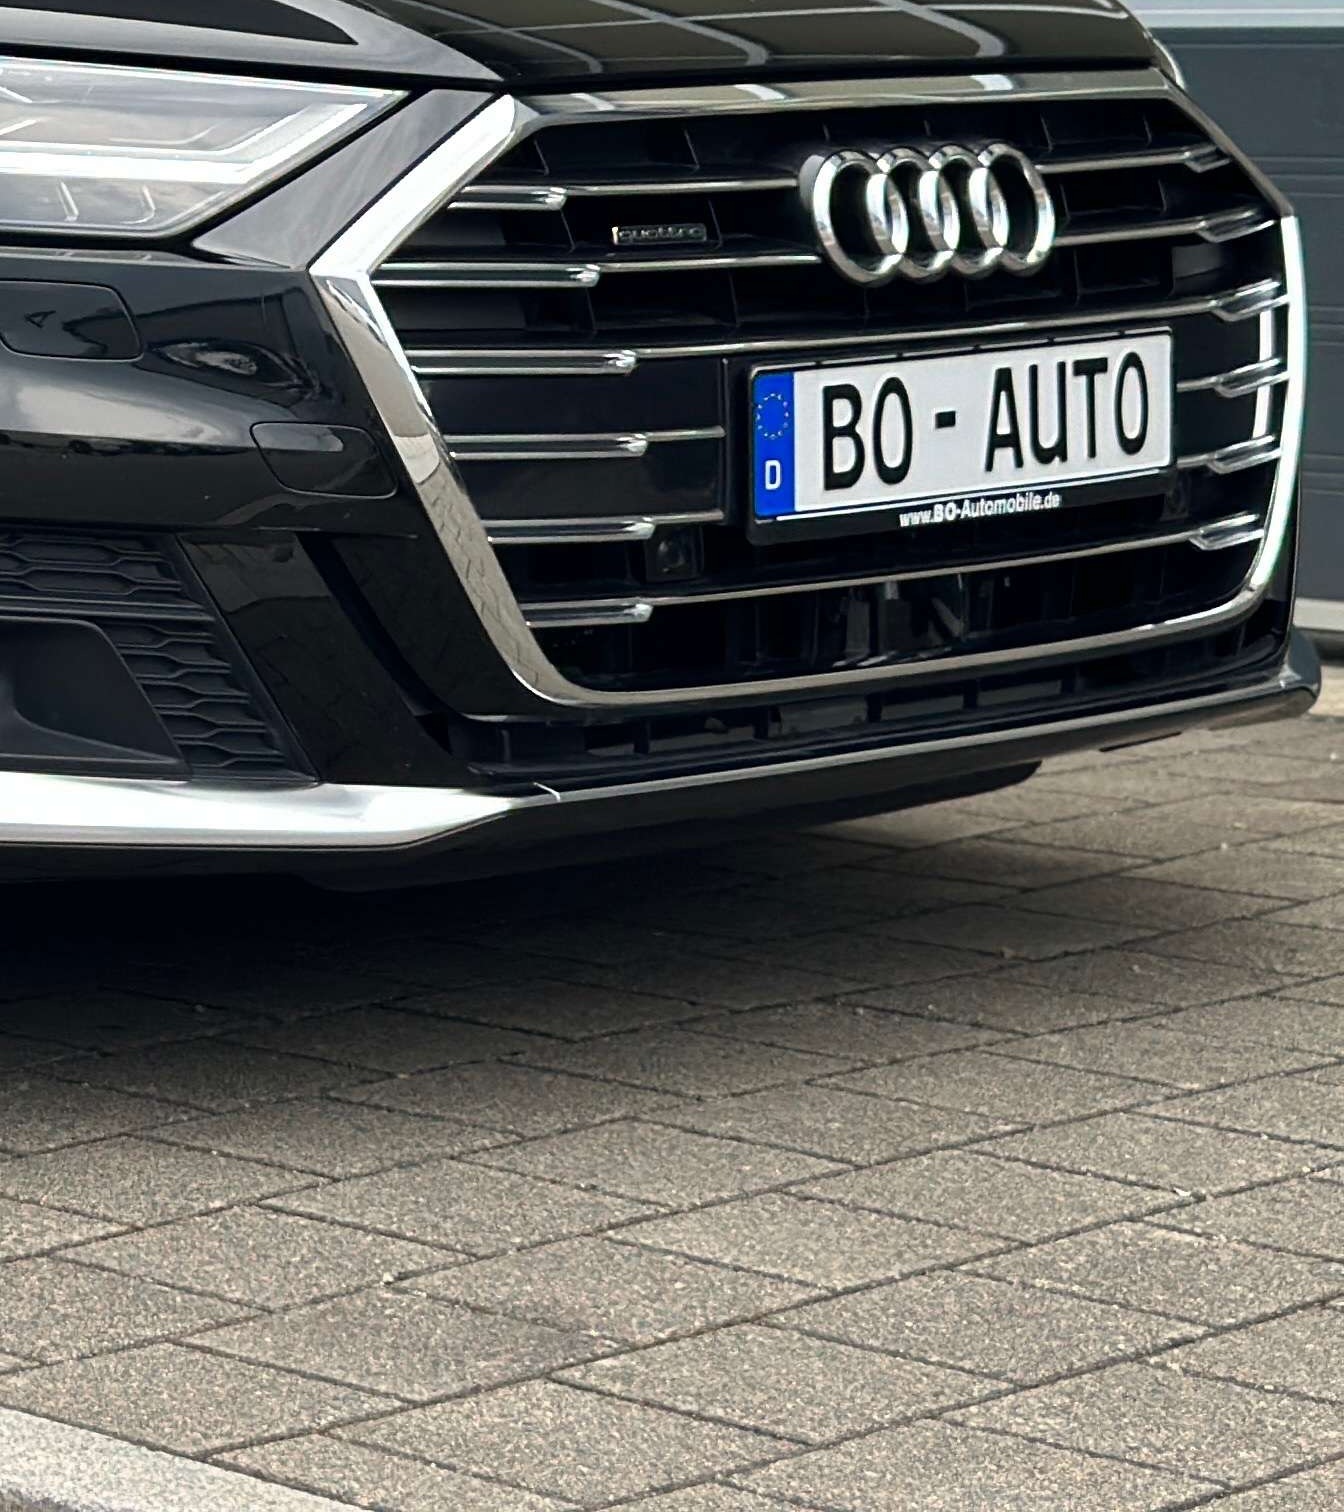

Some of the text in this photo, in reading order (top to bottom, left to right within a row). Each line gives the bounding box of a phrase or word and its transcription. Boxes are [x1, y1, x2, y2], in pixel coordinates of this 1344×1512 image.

[822, 376, 913, 491] BO
[985, 351, 1149, 472] AUTO
[765, 459, 781, 490] D
[898, 490, 1062, 528] www.BO-Automobile.de
